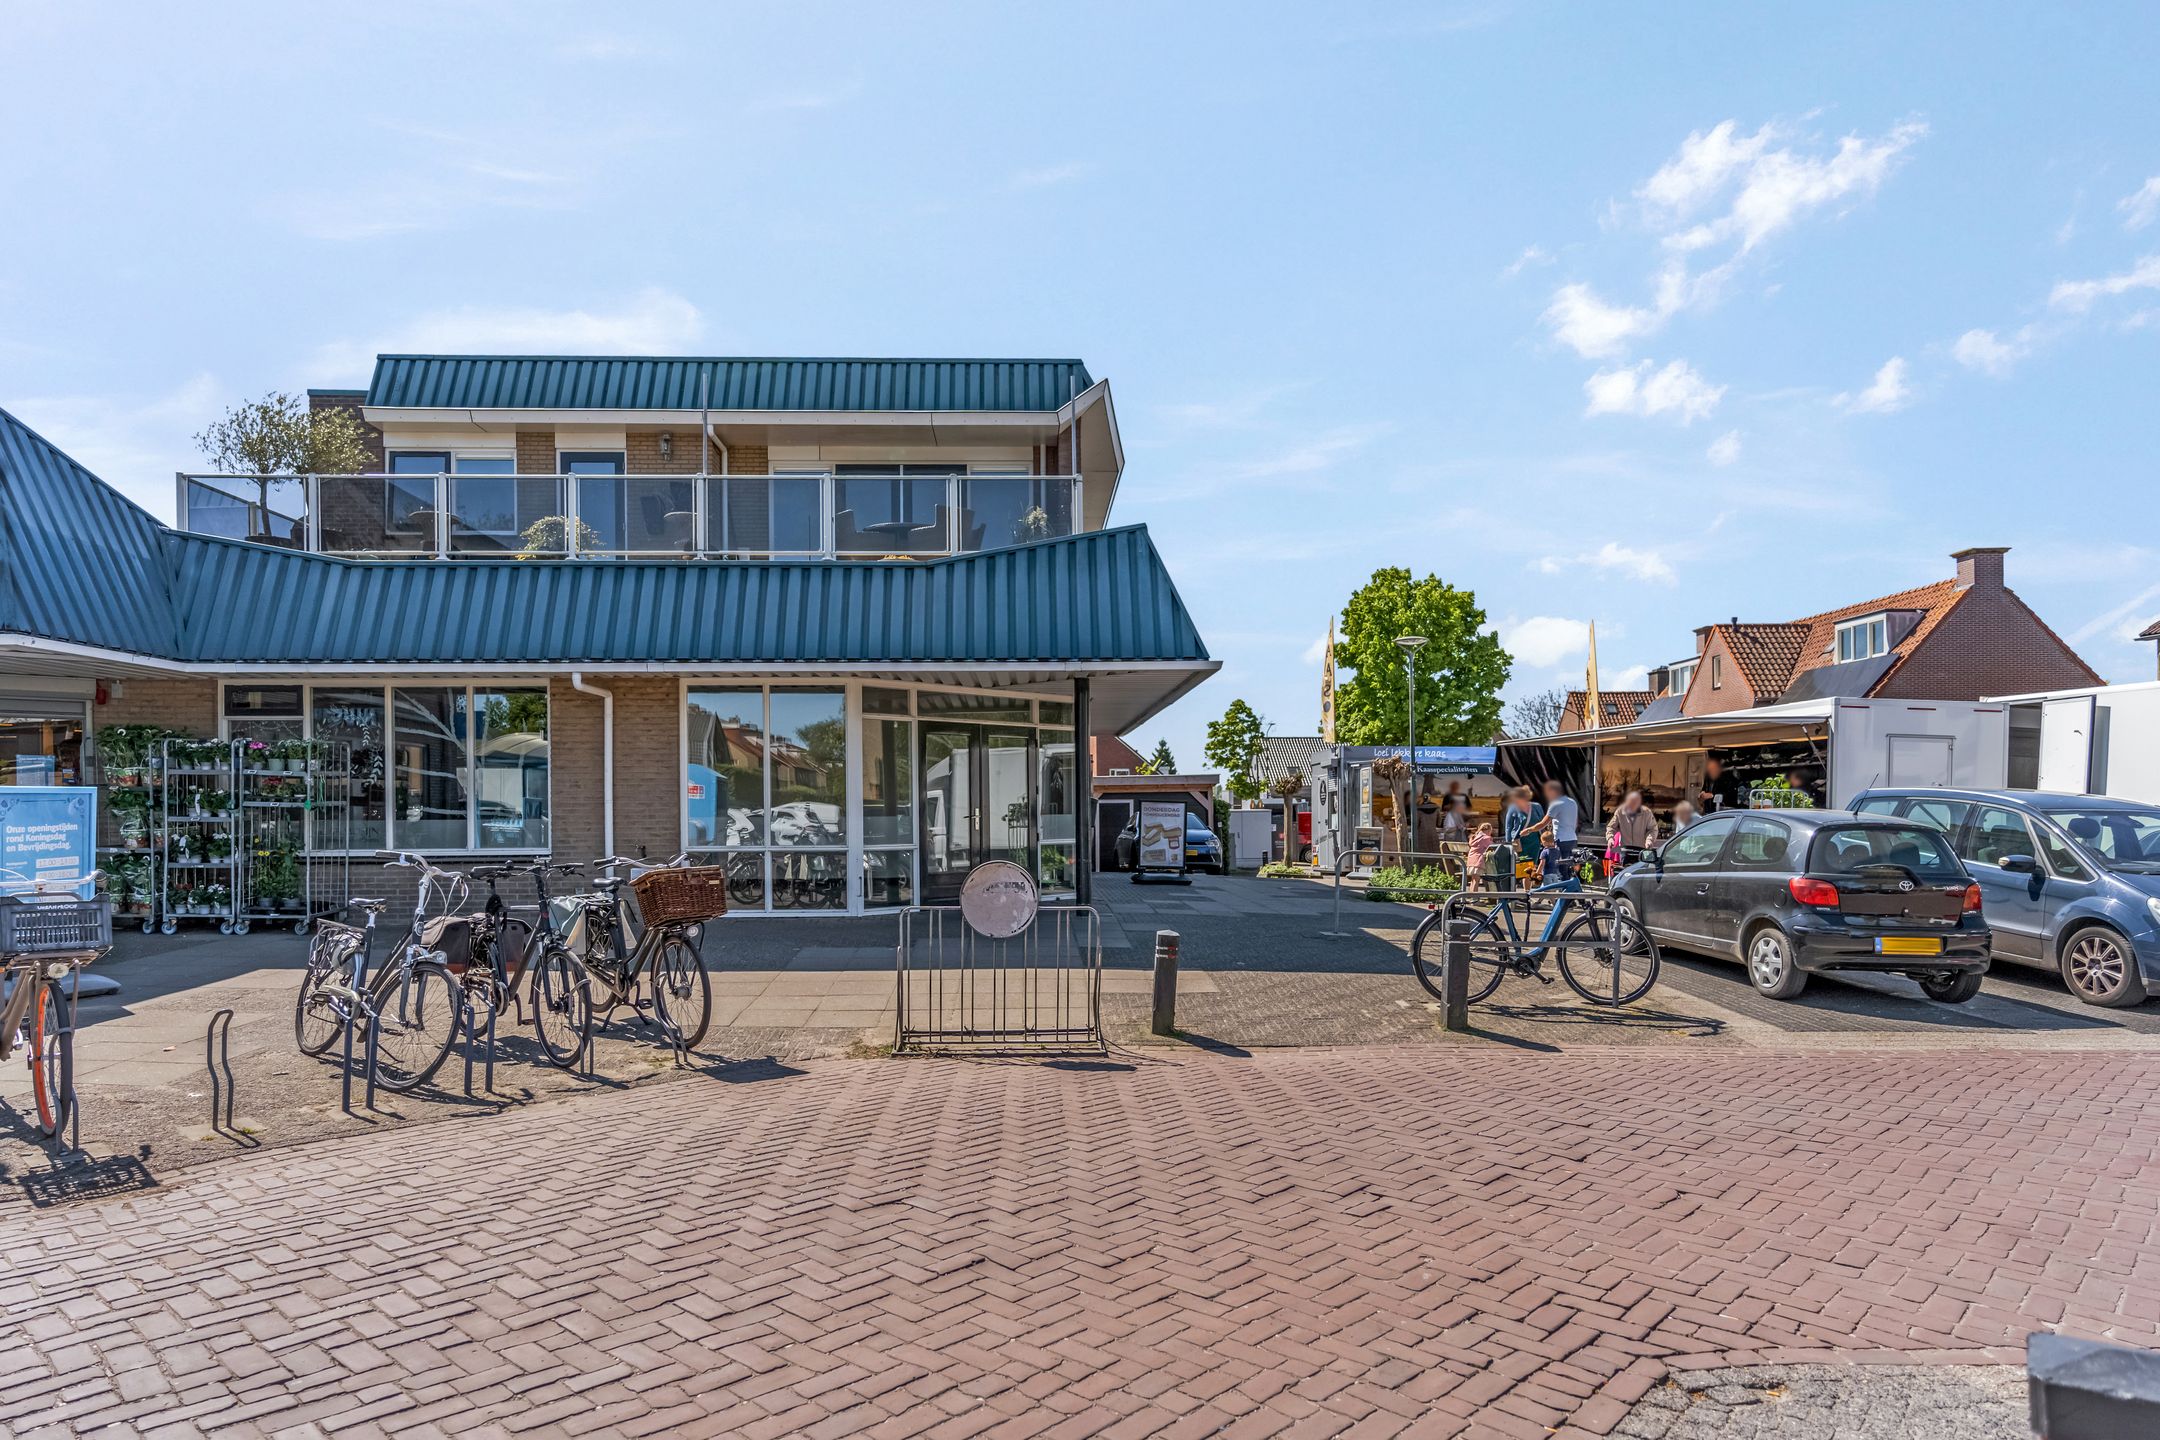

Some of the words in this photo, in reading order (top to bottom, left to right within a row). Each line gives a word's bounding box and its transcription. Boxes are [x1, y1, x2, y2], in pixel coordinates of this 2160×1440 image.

[1391, 748, 1422, 758] lekkre
[1424, 748, 1446, 758] kaas
[1417, 765, 1478, 774] Kaasspecialiteiten
[6, 825, 26, 833] Onze
[27, 823, 78, 833] openingstijden
[26, 833, 66, 842] Koningsdag
